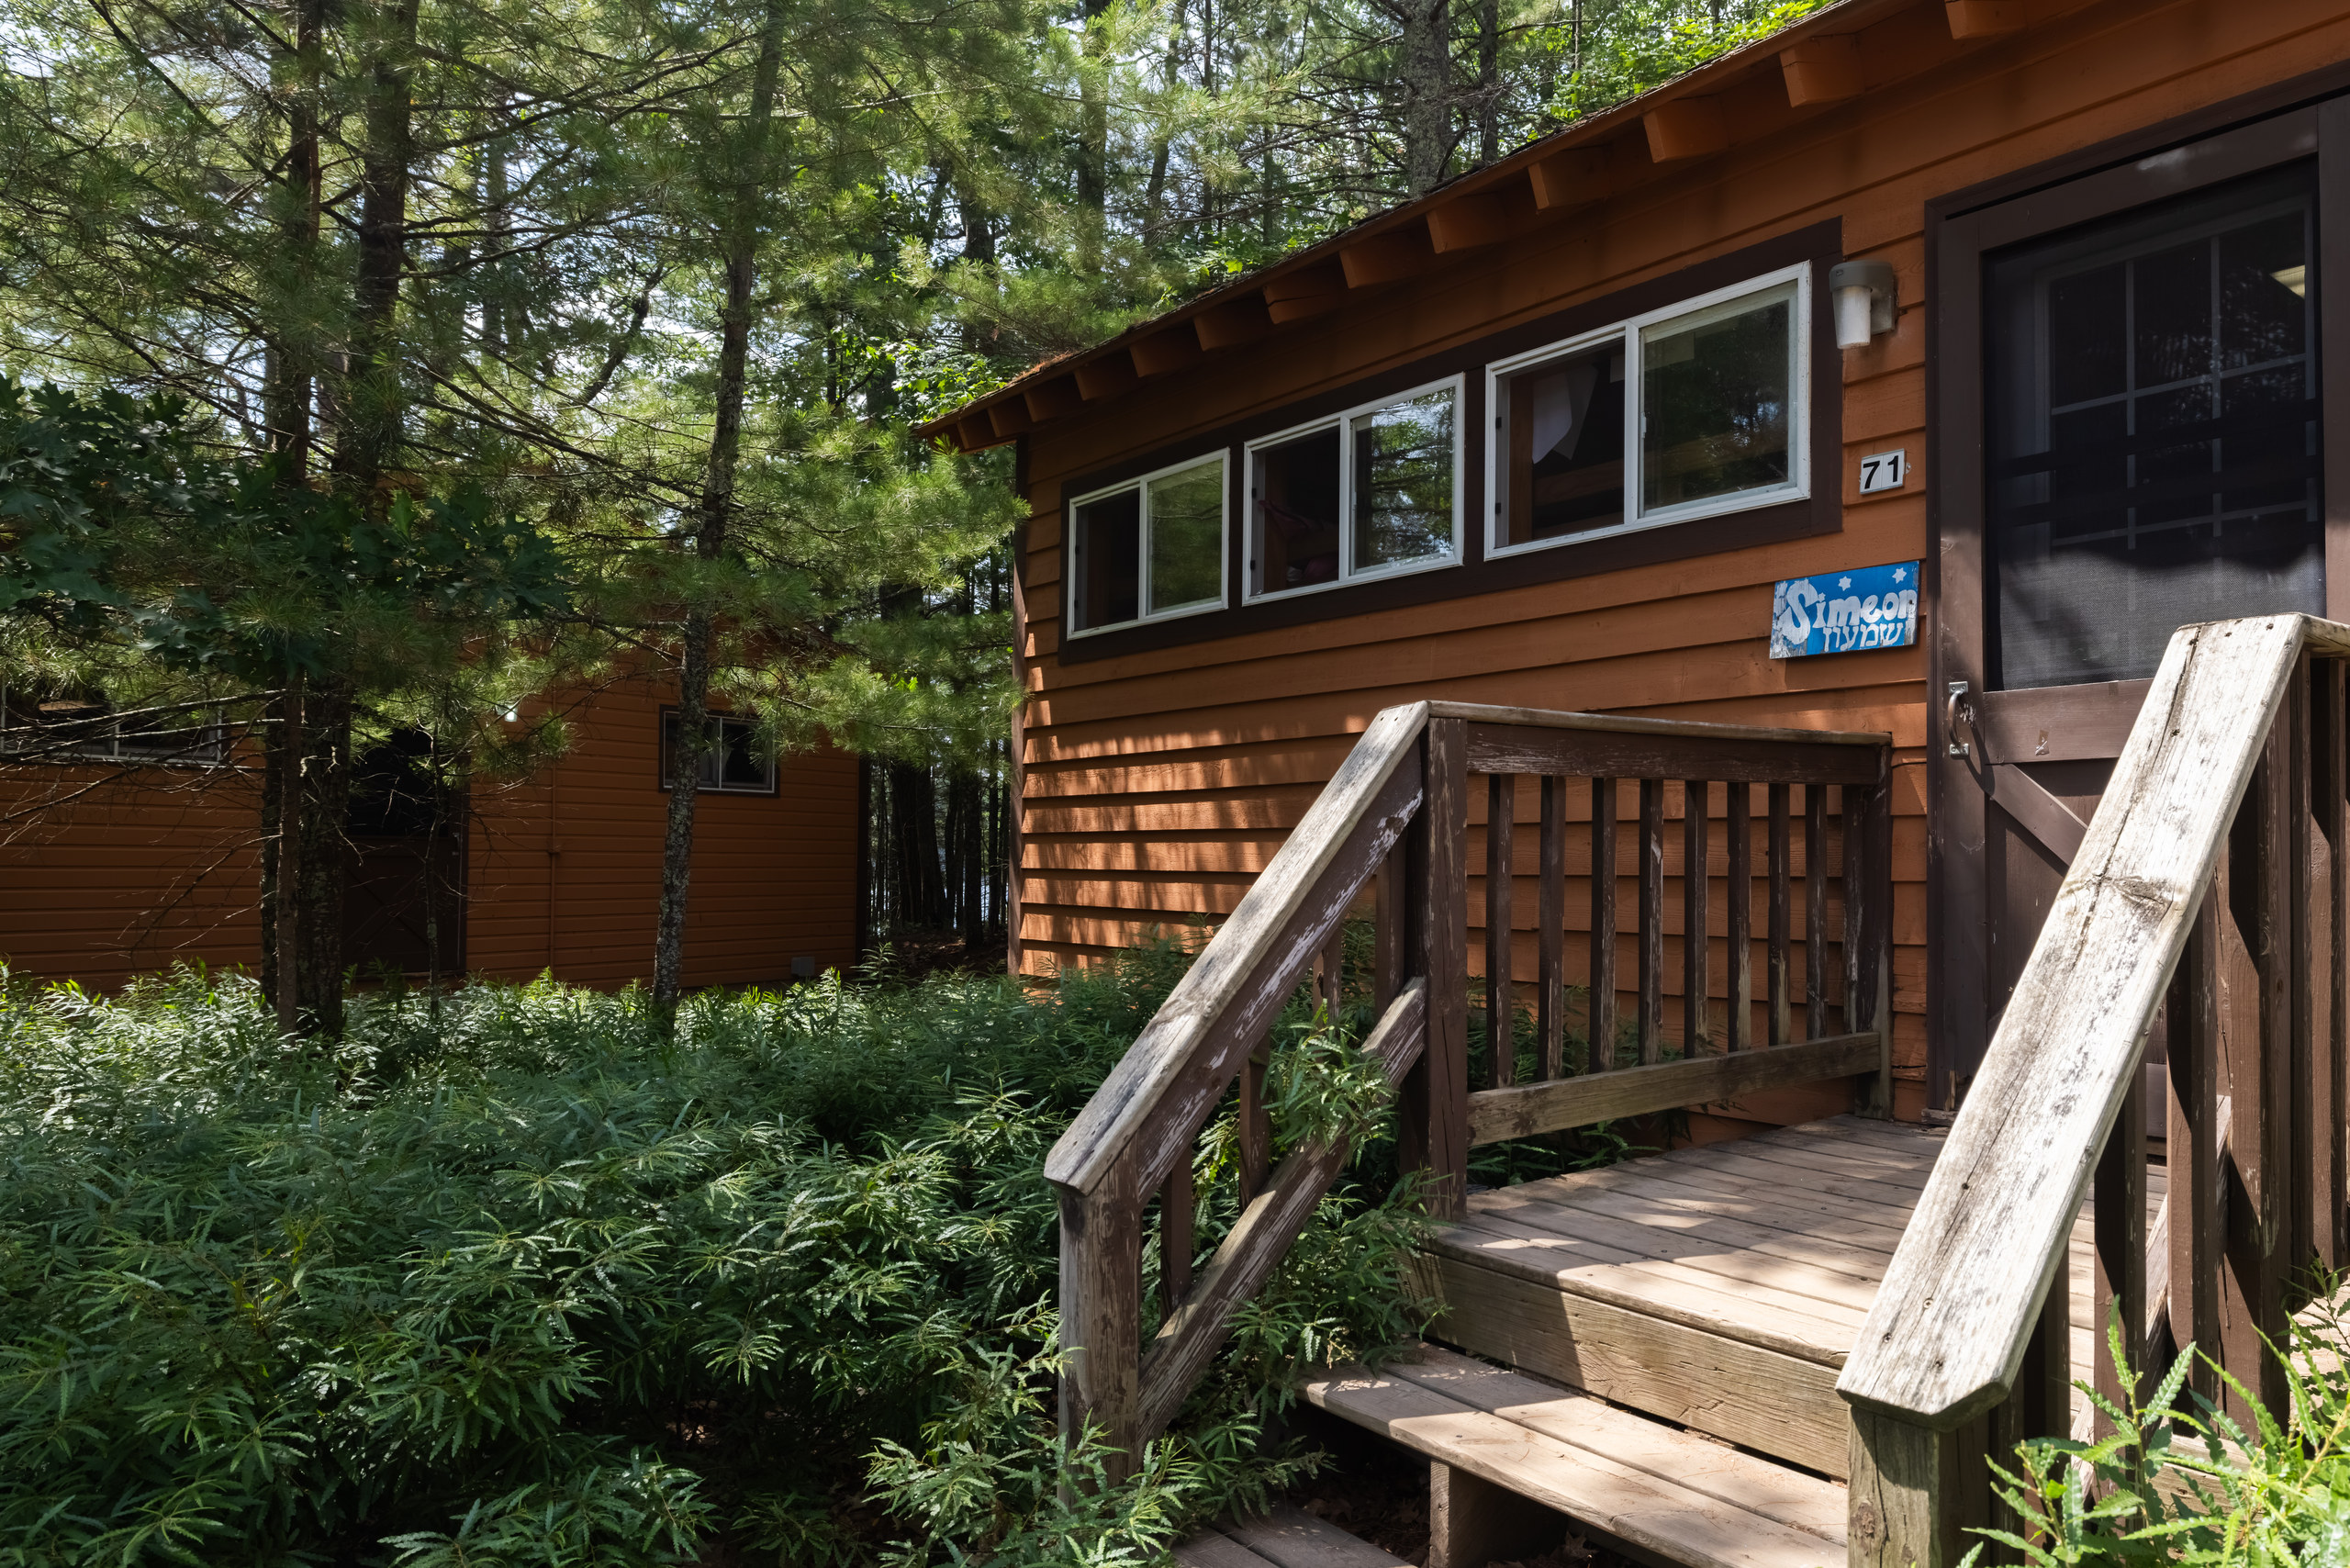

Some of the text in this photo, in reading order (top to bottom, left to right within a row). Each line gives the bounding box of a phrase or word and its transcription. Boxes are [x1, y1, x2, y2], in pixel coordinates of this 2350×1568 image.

[1863, 455, 1898, 489] 71
[1778, 580, 1918, 644] Simeon
[1823, 622, 1904, 652] שמעון
